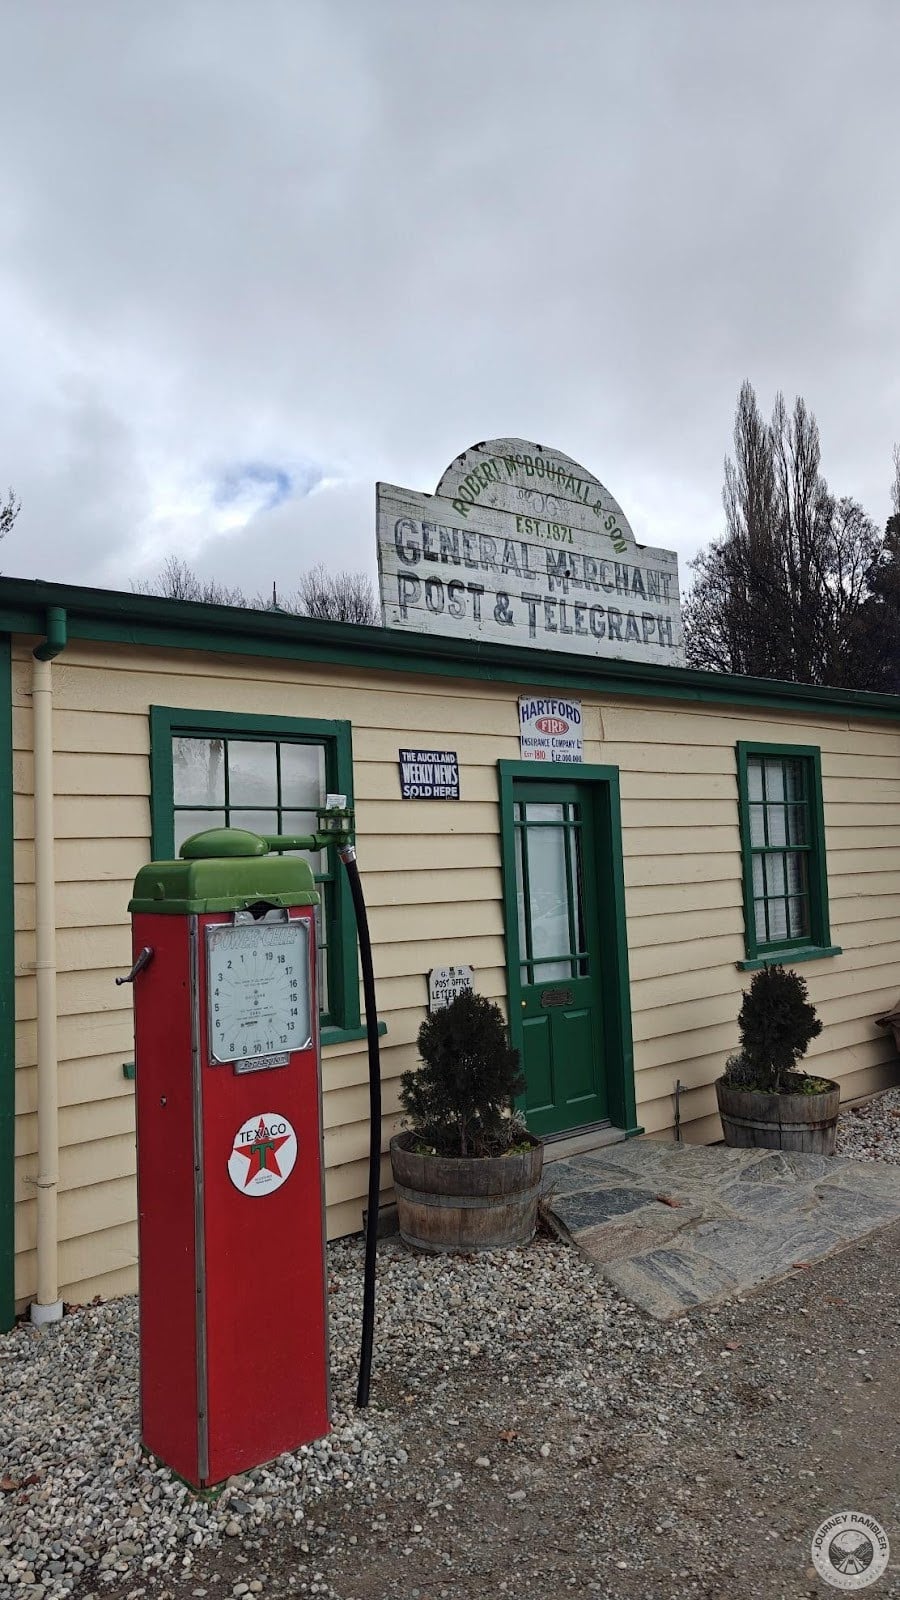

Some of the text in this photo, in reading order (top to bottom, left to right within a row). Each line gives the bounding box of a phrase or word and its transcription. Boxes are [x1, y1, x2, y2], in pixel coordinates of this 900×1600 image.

[452, 458, 501, 518] ROBERT
[592, 500, 602, 518] &
[604, 514, 627, 554] SON
[395, 517, 671, 604] GENERAL MERCHANT
[397, 568, 673, 648] POST & TELEGRAPH
[521, 699, 581, 724] HARTFORD
[541, 720, 565, 733] FIRE
[402, 751, 456, 764] THE AUCKLAND
[402, 762, 458, 786] WEEKLY NEWS
[403, 785, 458, 797] SOLD HERE
[240, 954, 244, 963] 1
[265, 951, 274, 960] 19
[277, 954, 286, 963] 18
[227, 960, 233, 969] 2
[285, 966, 293, 975] 17
[218, 972, 223, 981] 3
[289, 979, 298, 988] 16
[435, 977, 471, 988] POST OFFICE
[214, 988, 220, 996] 4
[290, 993, 298, 1002] 15
[215, 1003, 220, 1012] 5
[290, 1007, 299, 1016] 14
[215, 1019, 221, 1028] 6
[287, 1021, 295, 1030] 13
[220, 1033, 225, 1042] 7
[279, 1034, 288, 1043] 12
[229, 1043, 235, 1052] 8
[242, 1045, 248, 1055] 9
[253, 1044, 262, 1053] 10
[266, 1041, 274, 1050] 11
[240, 1123, 287, 1143] TEXACO
[251, 1140, 275, 1169] T
